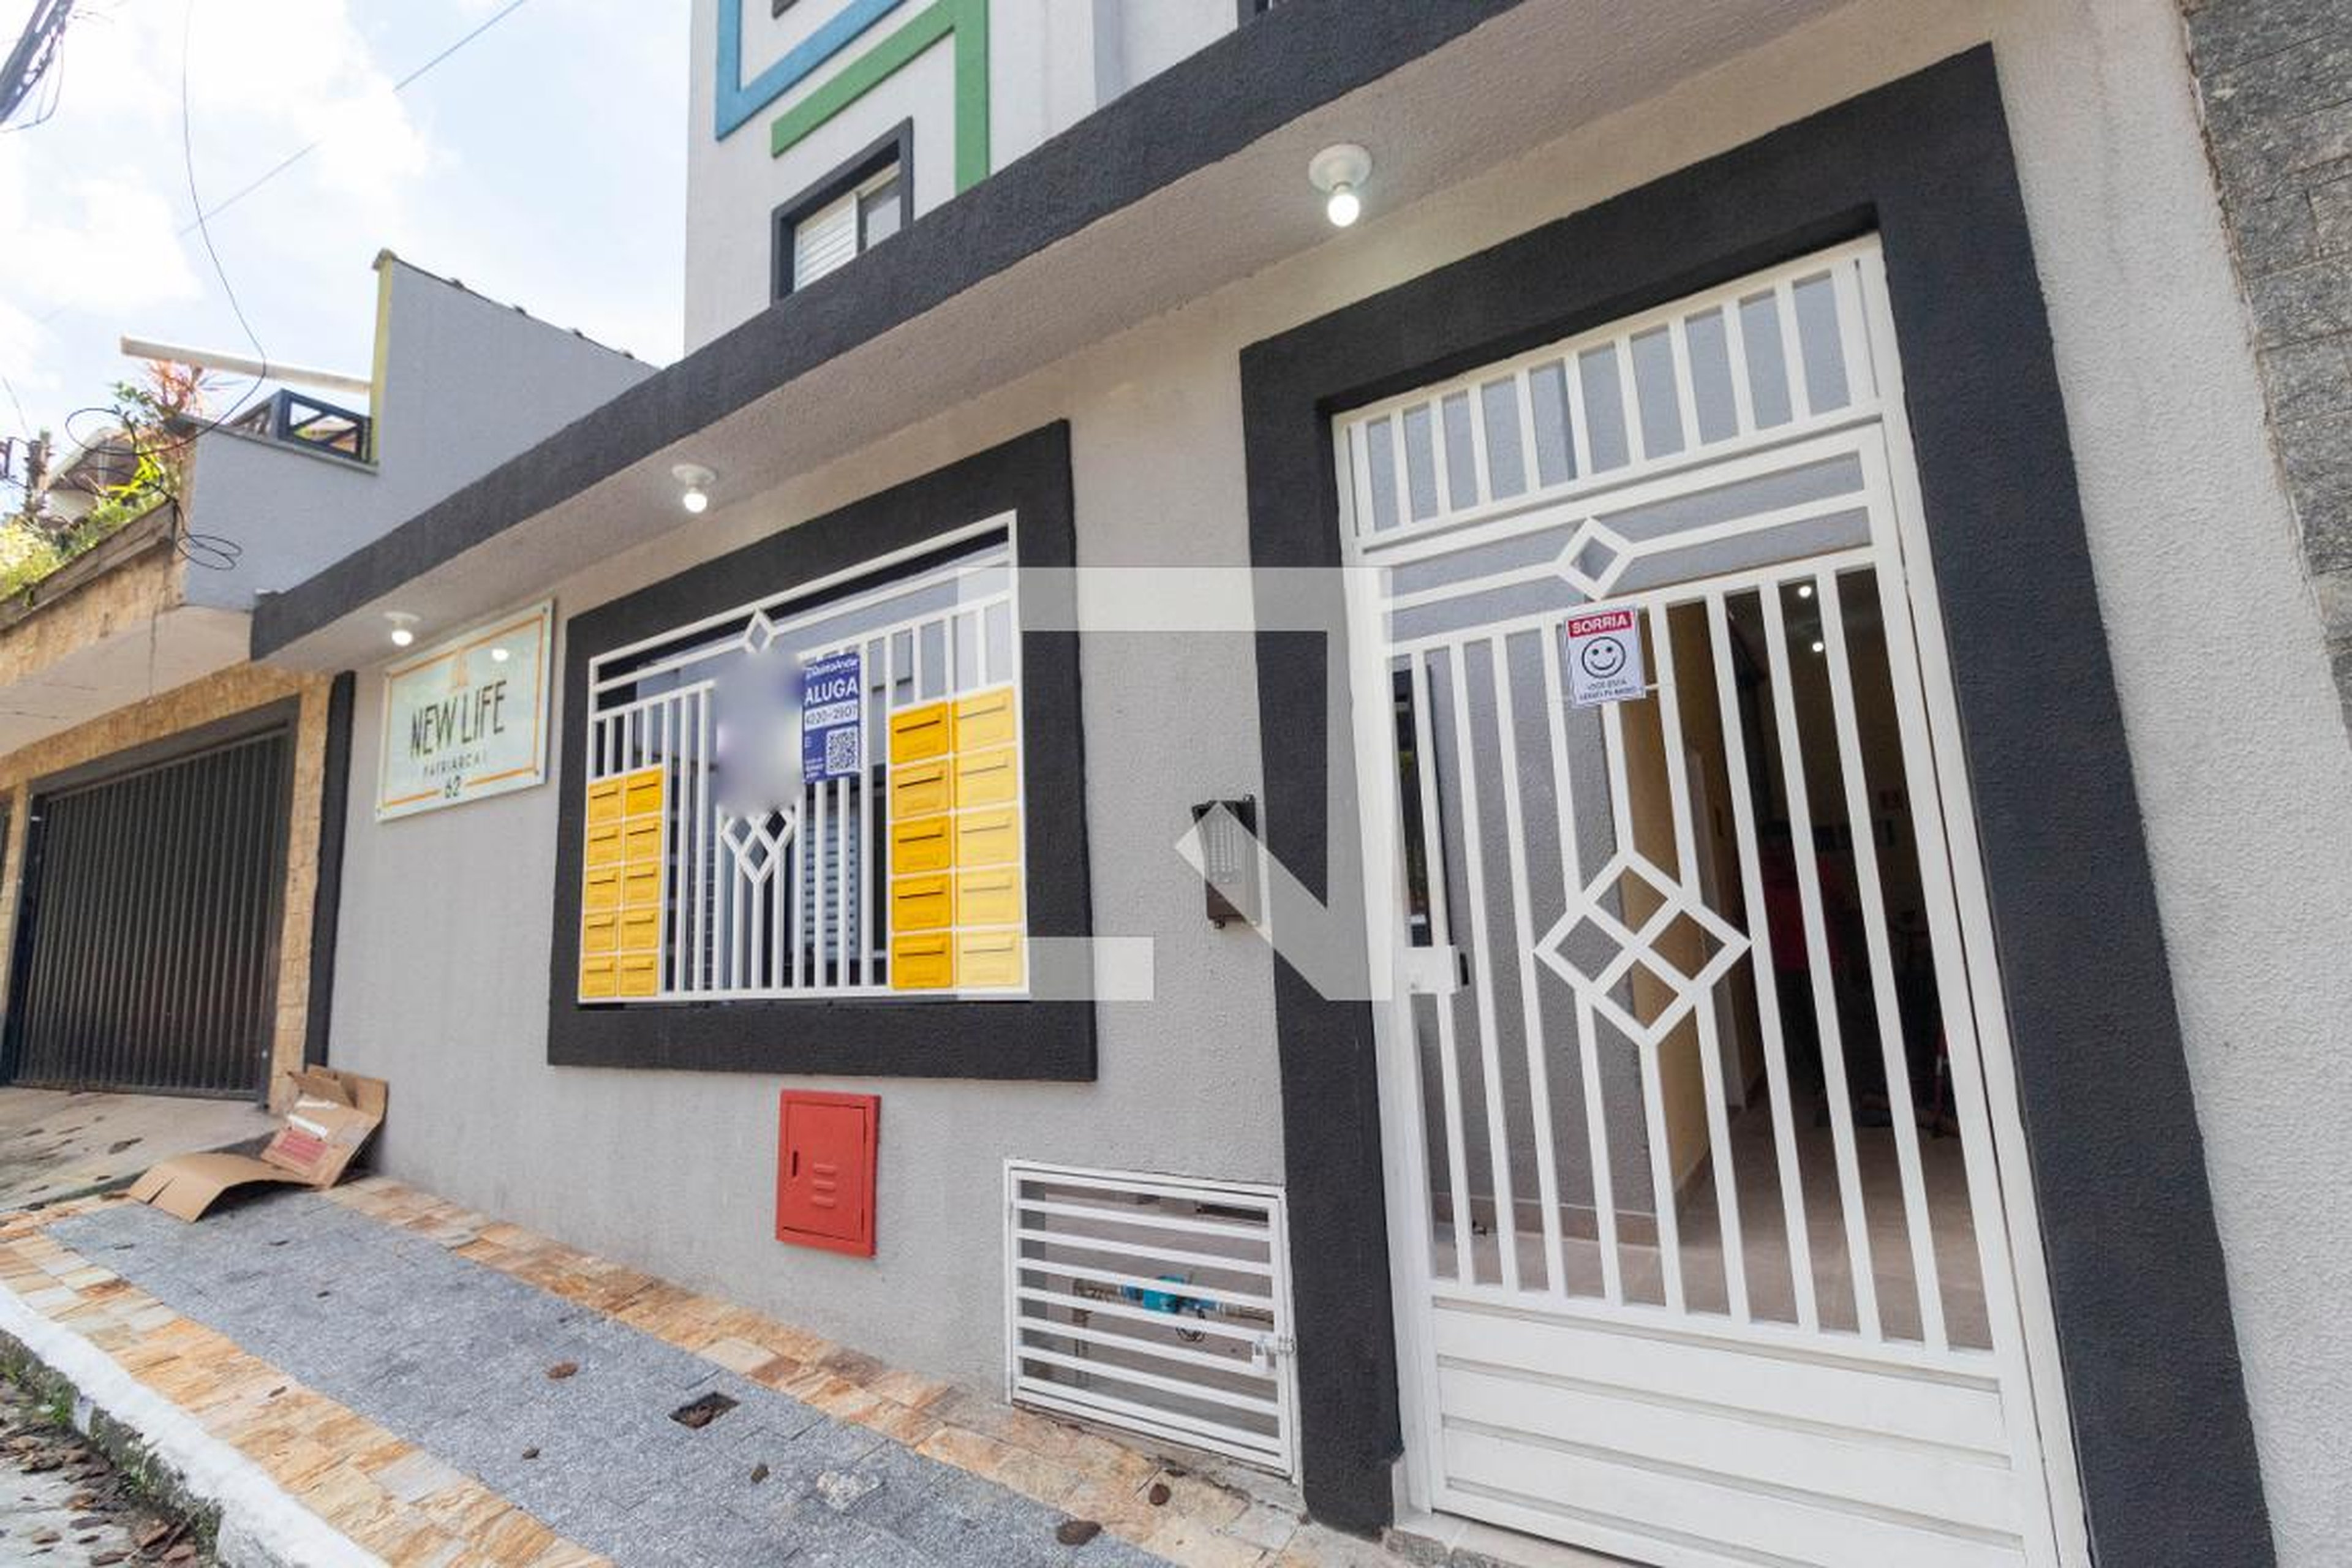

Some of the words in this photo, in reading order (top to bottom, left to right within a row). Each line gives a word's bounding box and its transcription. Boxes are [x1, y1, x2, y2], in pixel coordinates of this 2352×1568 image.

[1572, 613, 1628, 635] SORRIA
[804, 676, 859, 707] ALUGA
[410, 696, 458, 758] NEW
[461, 680, 507, 744] LIFE
